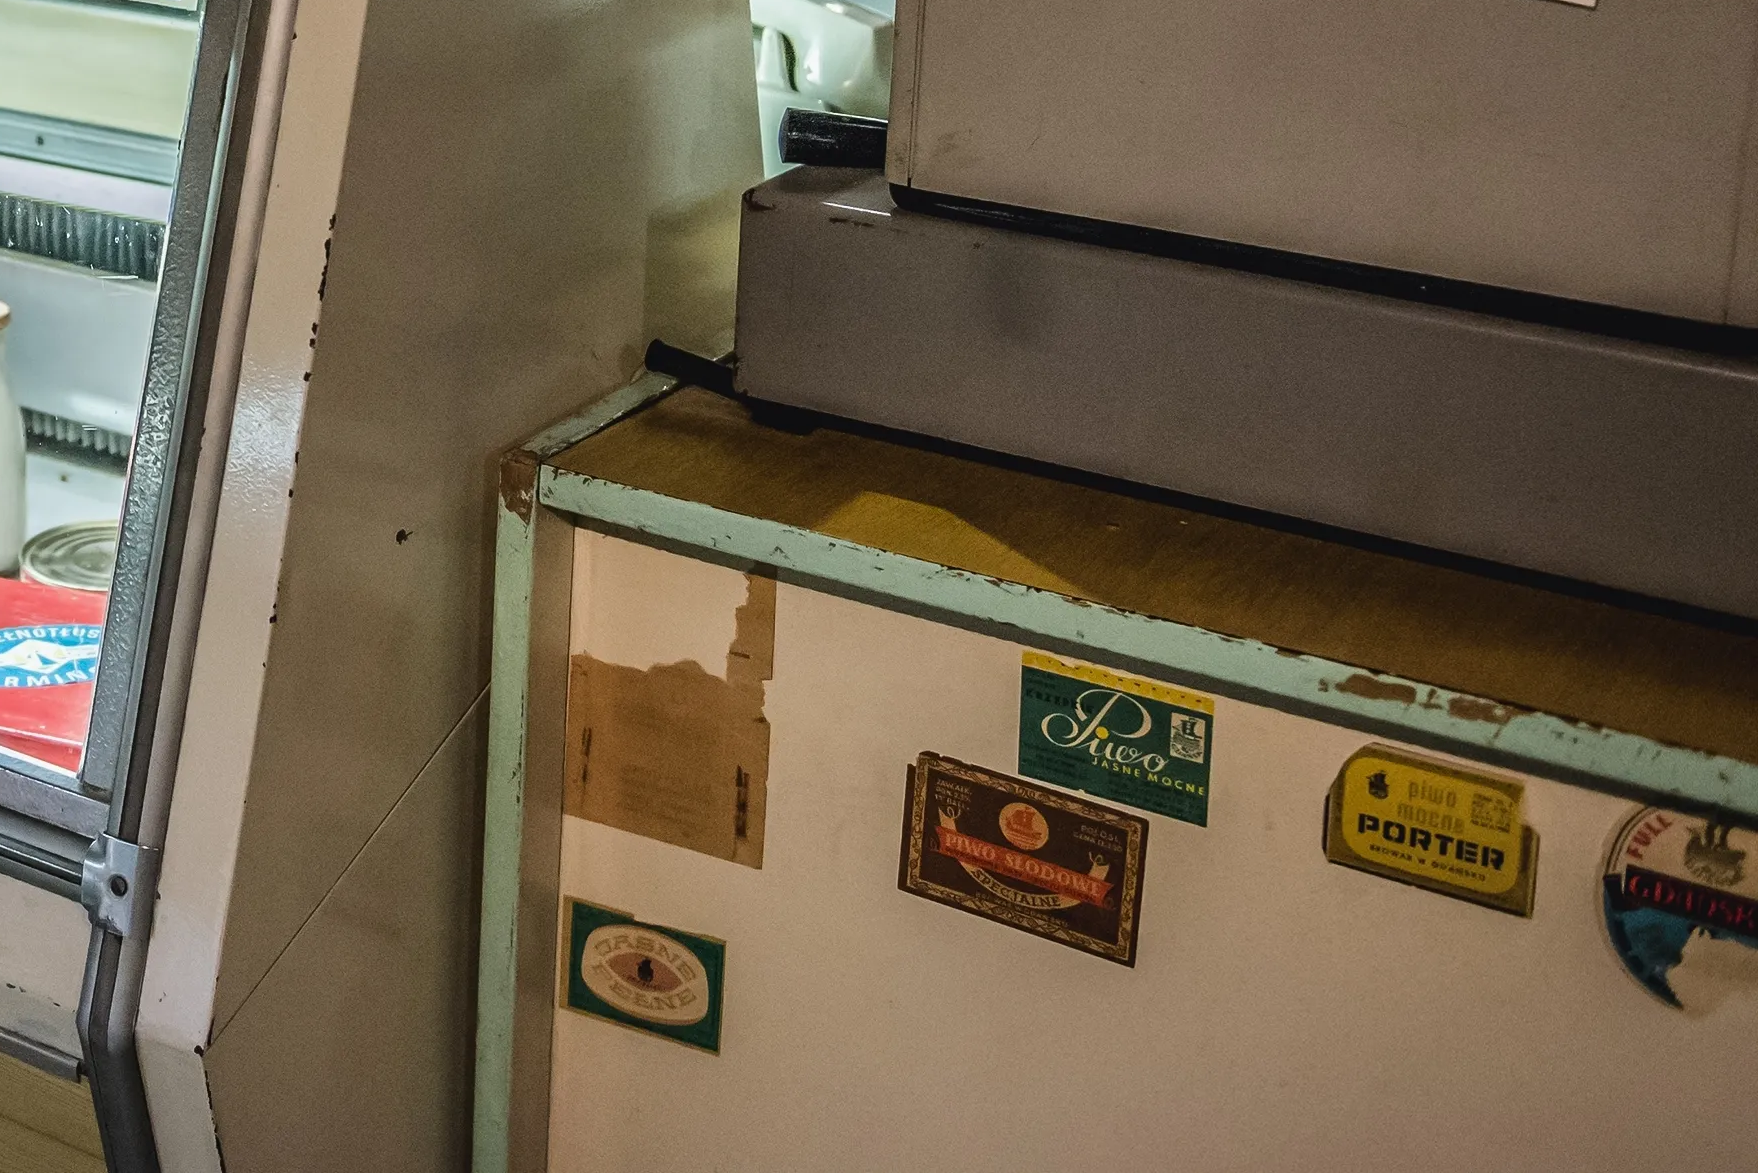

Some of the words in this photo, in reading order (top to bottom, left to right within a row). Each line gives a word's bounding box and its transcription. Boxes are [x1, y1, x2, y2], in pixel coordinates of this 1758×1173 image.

[1040, 688, 1170, 773] Piwo
[1091, 755, 1142, 777] JASNE
[1146, 772, 1206, 797] MOCNE
[944, 833, 996, 861] PIWO
[1357, 812, 1506, 872] PORTER
[1625, 813, 1675, 862] FULL
[593, 934, 697, 983] JASNE
